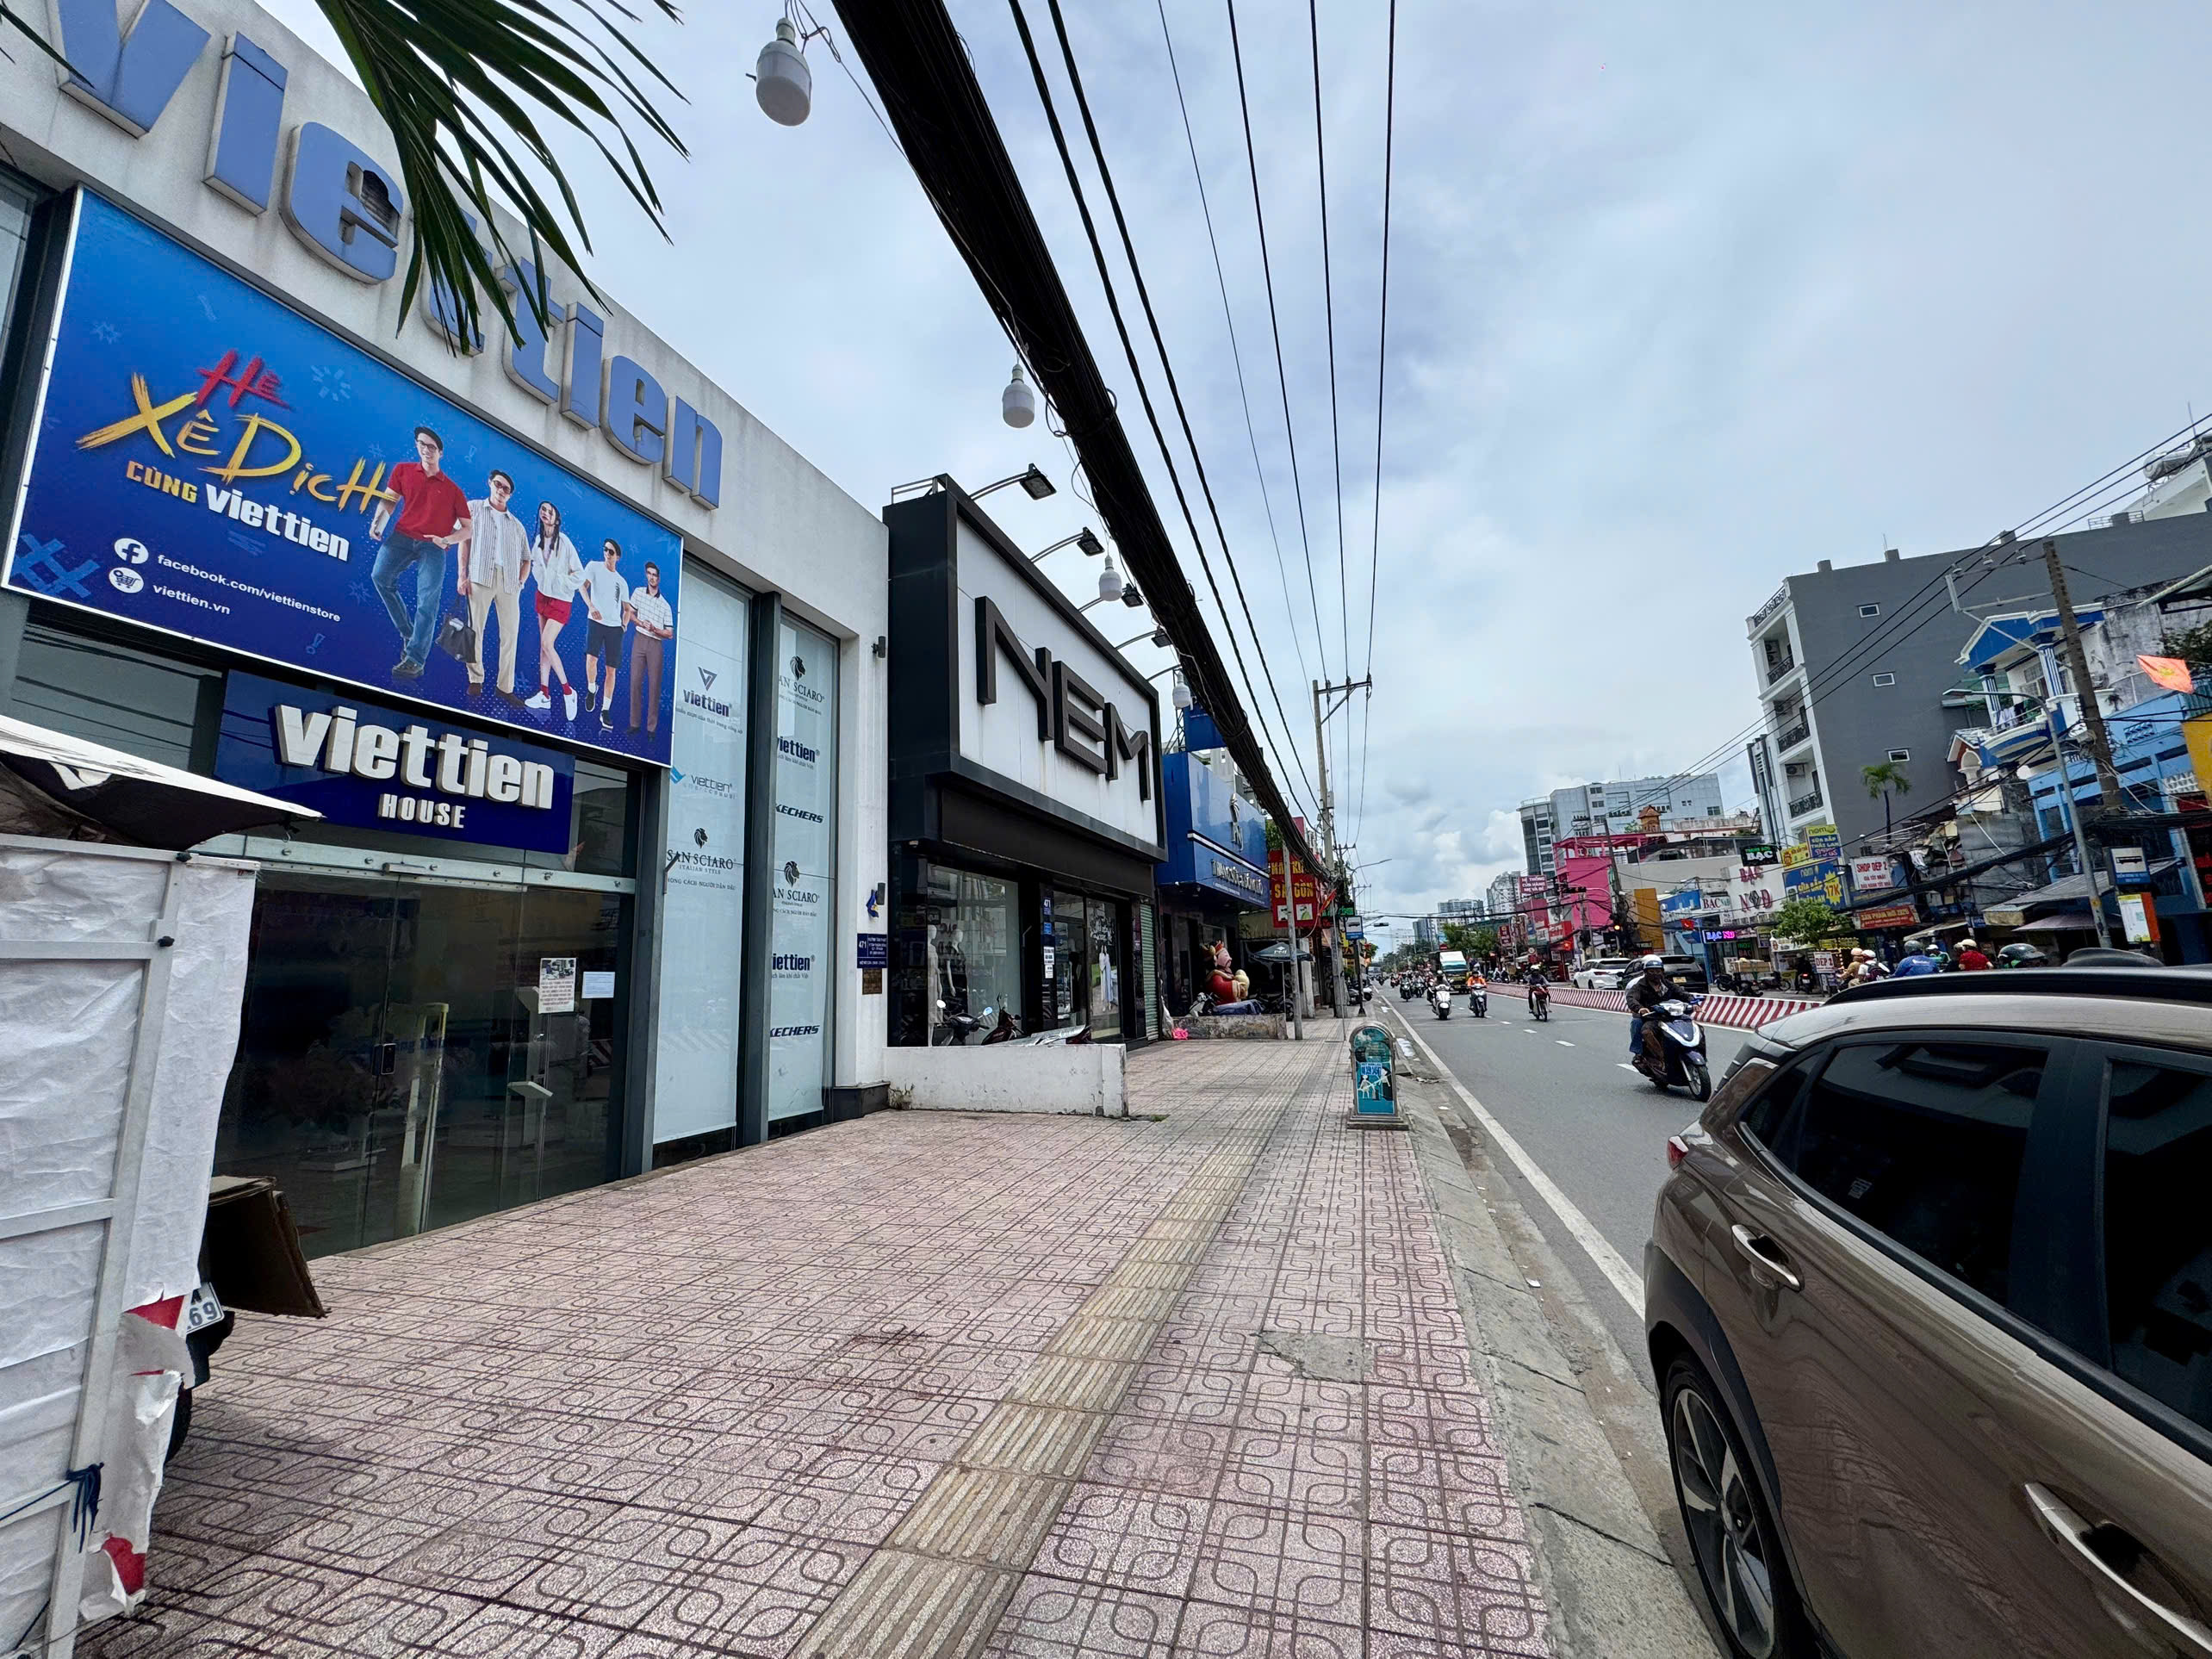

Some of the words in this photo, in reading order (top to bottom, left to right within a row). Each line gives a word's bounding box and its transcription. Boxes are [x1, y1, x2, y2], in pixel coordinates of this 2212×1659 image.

[157, 554, 341, 623] facebook.com/viettienstore
[152, 583, 231, 615] viettien.vn
[793, 681, 823, 703] SCIARO
[975, 596, 1151, 800] NEM
[378, 793, 466, 829] HOUSE
[775, 804, 824, 823] KECHERS
[693, 853, 734, 870] SCIARO
[1856, 863, 1871, 873] SHOP
[787, 889, 818, 904] SCIARO
[772, 953, 811, 971] iettien
[770, 1025, 820, 1037] KECHERS
